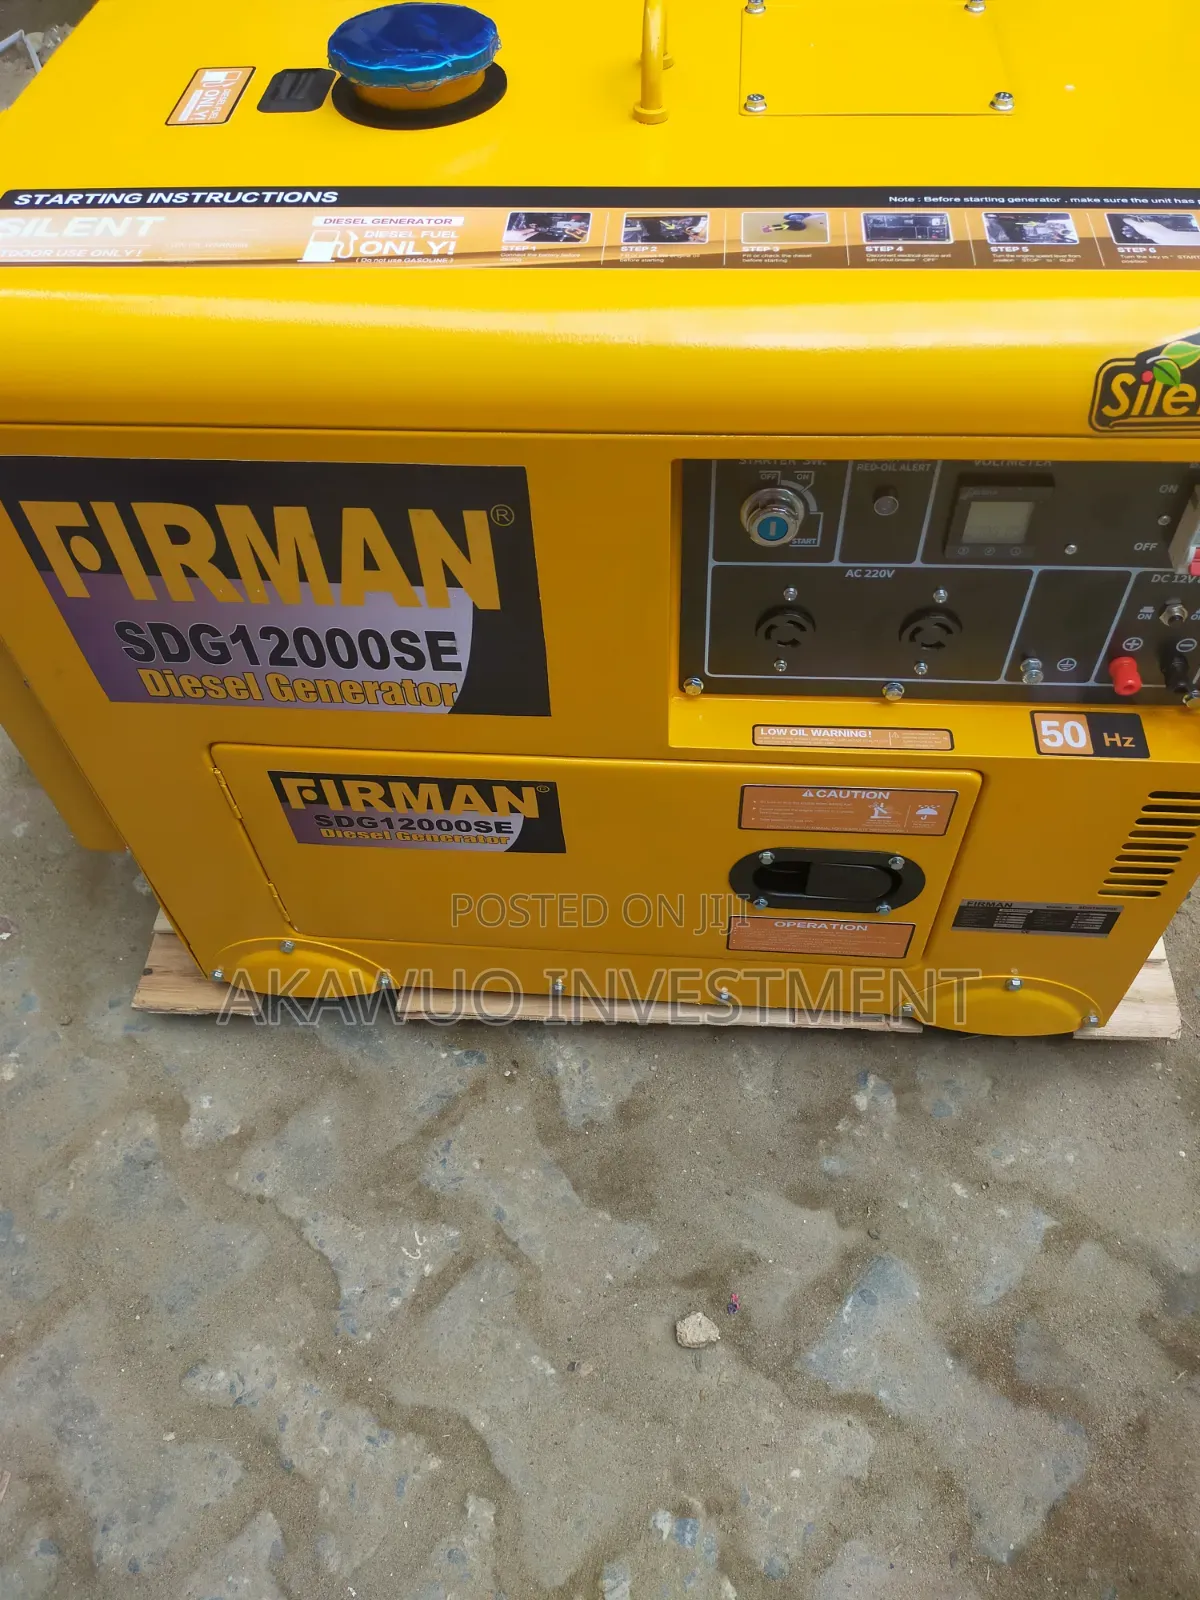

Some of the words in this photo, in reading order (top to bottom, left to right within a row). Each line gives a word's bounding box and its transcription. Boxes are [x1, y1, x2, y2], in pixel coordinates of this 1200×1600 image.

[14, 193, 142, 206] STARTING
[146, 191, 339, 204] INSTRUCTIONS
[56, 249, 88, 257] USE
[360, 241, 457, 256] ONLY!
[1101, 369, 1200, 418] Sile
[856, 463, 898, 471] RED-OIL
[899, 463, 932, 471] ALERT
[1158, 484, 1180, 494] ON
[1134, 542, 1158, 551] OFF
[18, 500, 502, 610] FIRMAN
[845, 569, 862, 578] AC
[864, 569, 896, 578] 220V
[1151, 574, 1171, 583] DC
[1172, 575, 1198, 583] 12V
[114, 620, 463, 672] SDG12000SE
[136, 668, 264, 702] Diesel
[264, 673, 459, 708] Generator
[760, 728, 787, 736] LOW
[790, 728, 808, 736] OIL
[811, 729, 872, 738] WARNING!
[1040, 720, 1086, 748] 50
[1102, 732, 1136, 748] Hz
[280, 777, 540, 818] FIRMAN
[816, 789, 890, 800] CAUTION
[313, 814, 514, 835] SDG12000SE
[320, 828, 391, 840] Diesel
[394, 831, 510, 845] Generator
[774, 920, 868, 932] OPERATION
